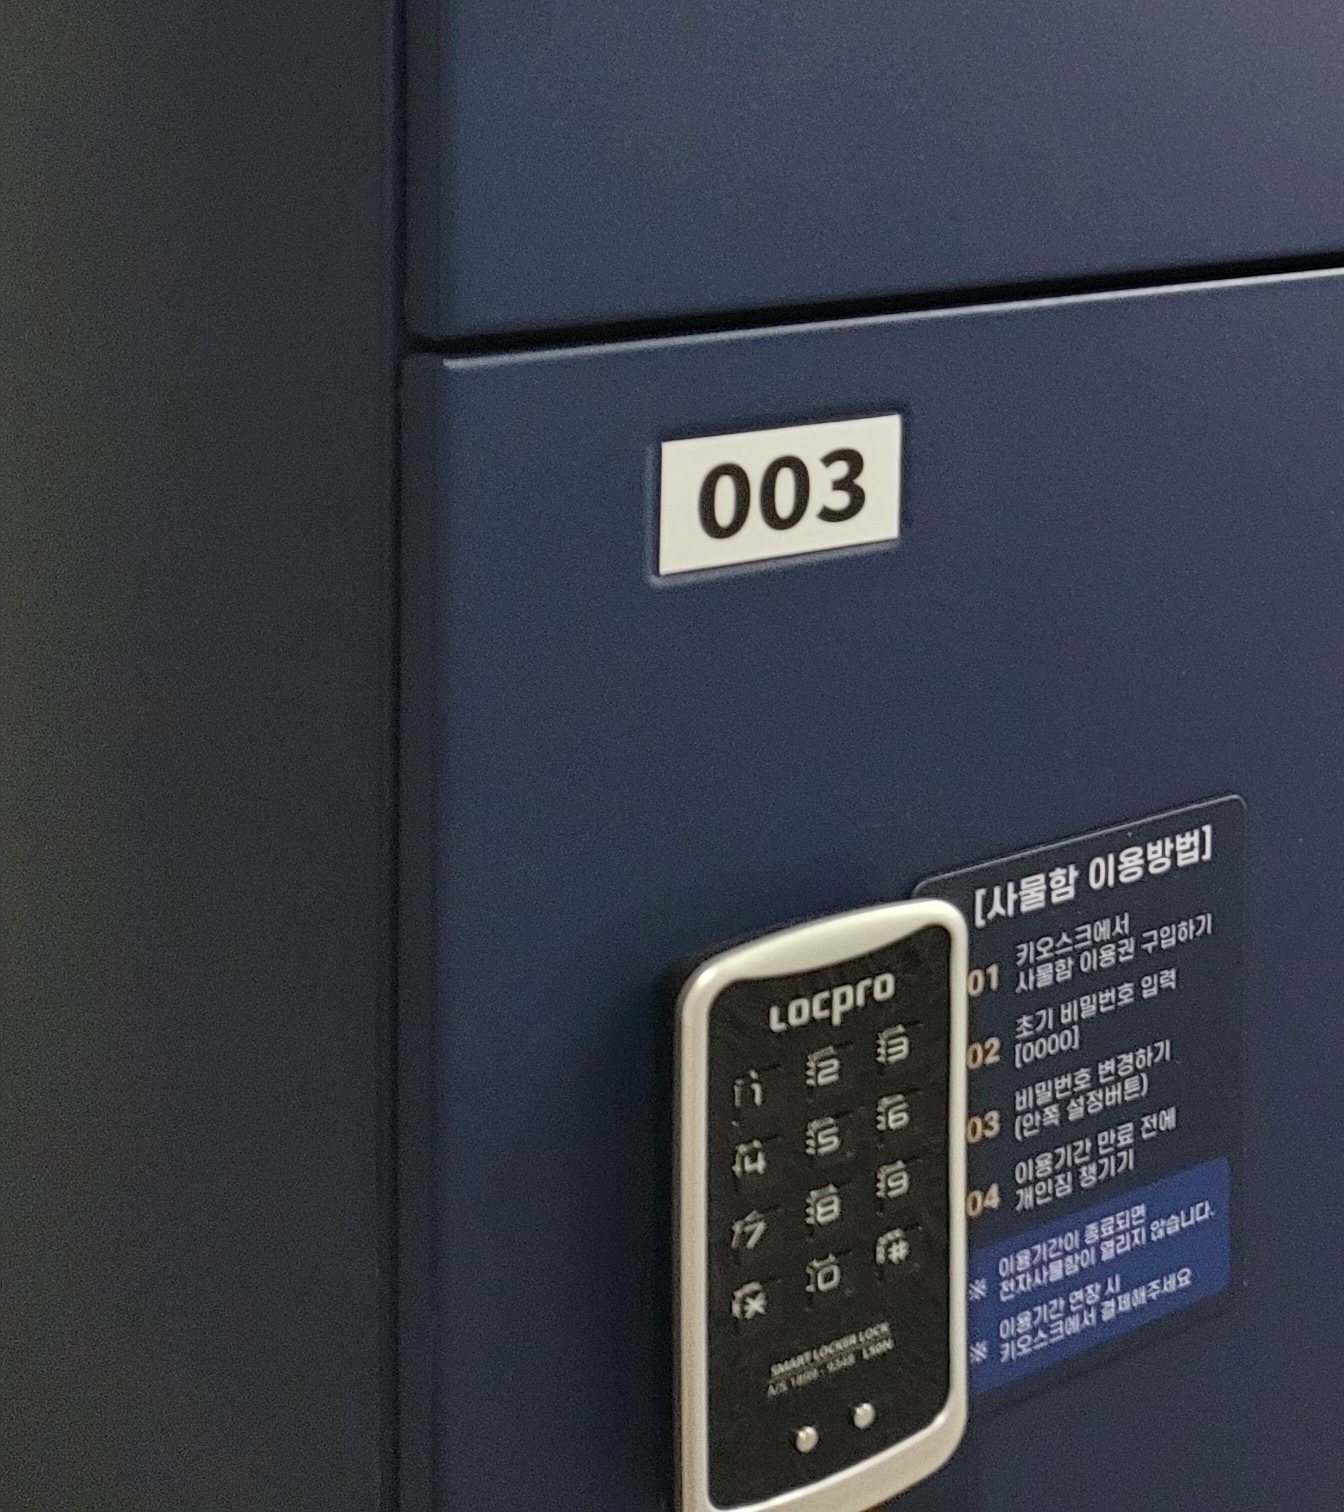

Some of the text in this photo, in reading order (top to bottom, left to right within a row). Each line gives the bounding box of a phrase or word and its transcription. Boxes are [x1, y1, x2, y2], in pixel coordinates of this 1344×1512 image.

[698, 448, 866, 540] 003
[974, 824, 1212, 928] [사물함 이용방법]
[967, 913, 1212, 996] 01 사물함 이용권 구입하기
[1016, 913, 1130, 966] 키오스크에서
[1015, 968, 1176, 1039] 초기 비밀번호 입력
[966, 1025, 1080, 1069] 02 [0000]
[1015, 1039, 1171, 1112] 비밀번호 변경하기
[966, 1072, 1148, 1143] 03 (안쪽 설정버튼)
[1015, 1106, 1176, 1184] 이용기간 만료 전에
[966, 1149, 1135, 1217] 04 개인짐 챙기기
[999, 1204, 1147, 1277] 이용기간이 종료되면
[999, 1250, 1096, 1301] 전자사물함이
[1100, 1227, 1147, 1260] 열리지
[1150, 1200, 1215, 1241] 않습니다.
[1000, 1274, 1121, 1339] 이용기간 연장 시
[1000, 1309, 1097, 1363] 키오스크에서
[1101, 1268, 1193, 1323] 결제해주세요
